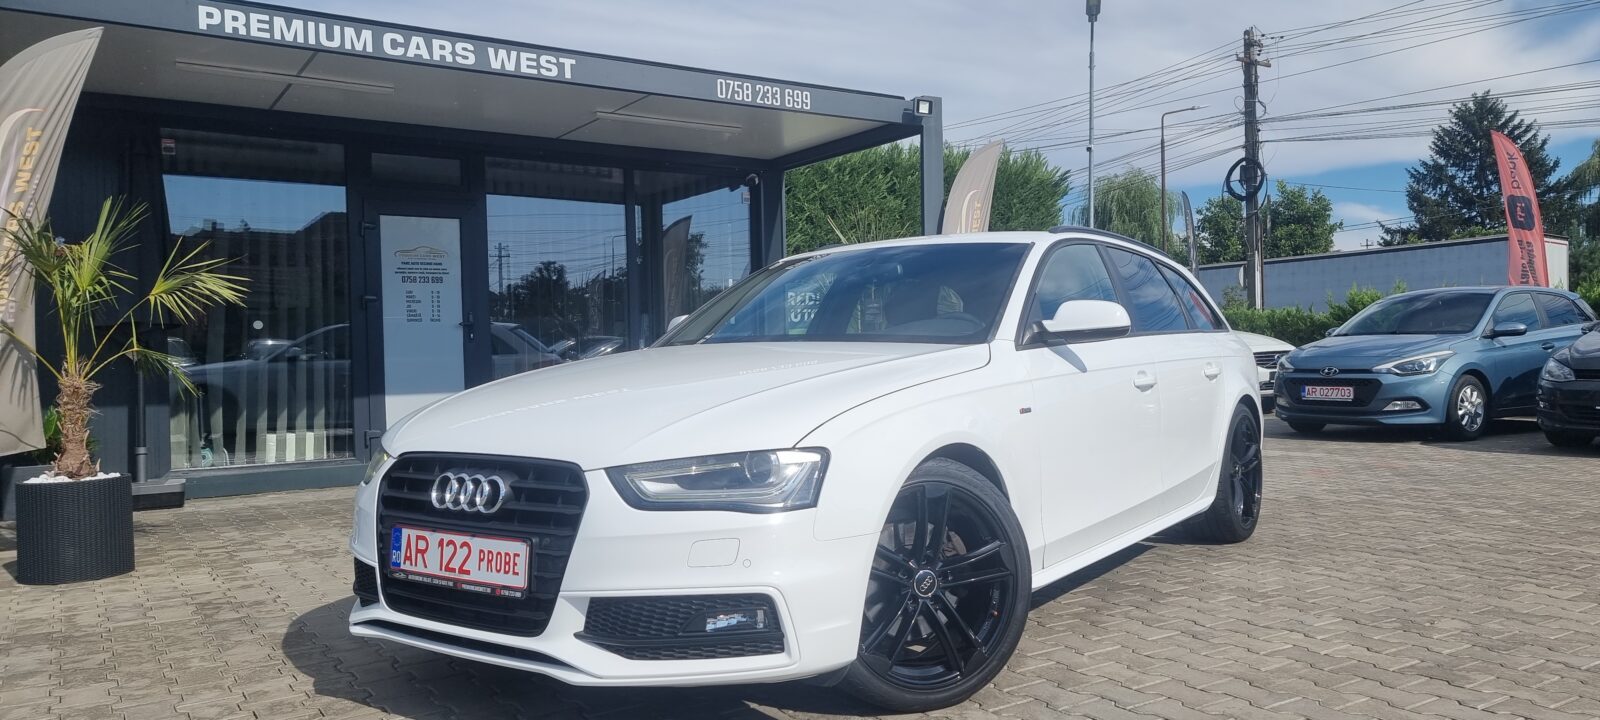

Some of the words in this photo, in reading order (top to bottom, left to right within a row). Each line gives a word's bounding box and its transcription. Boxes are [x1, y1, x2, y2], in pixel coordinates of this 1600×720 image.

[198, 5, 373, 53] PREMIUM
[383, 32, 476, 65] CARS
[487, 47, 576, 79] WEST
[717, 79, 752, 101] 0758
[756, 84, 780, 105] 233
[785, 89, 811, 110] 699
[15, 127, 42, 193] WEST
[1306, 387, 1318, 397] AR
[1320, 387, 1352, 398] 027703
[392, 550, 401, 564] RO
[403, 533, 430, 569] AR
[437, 537, 473, 576] 122
[478, 548, 521, 576] PROBE
